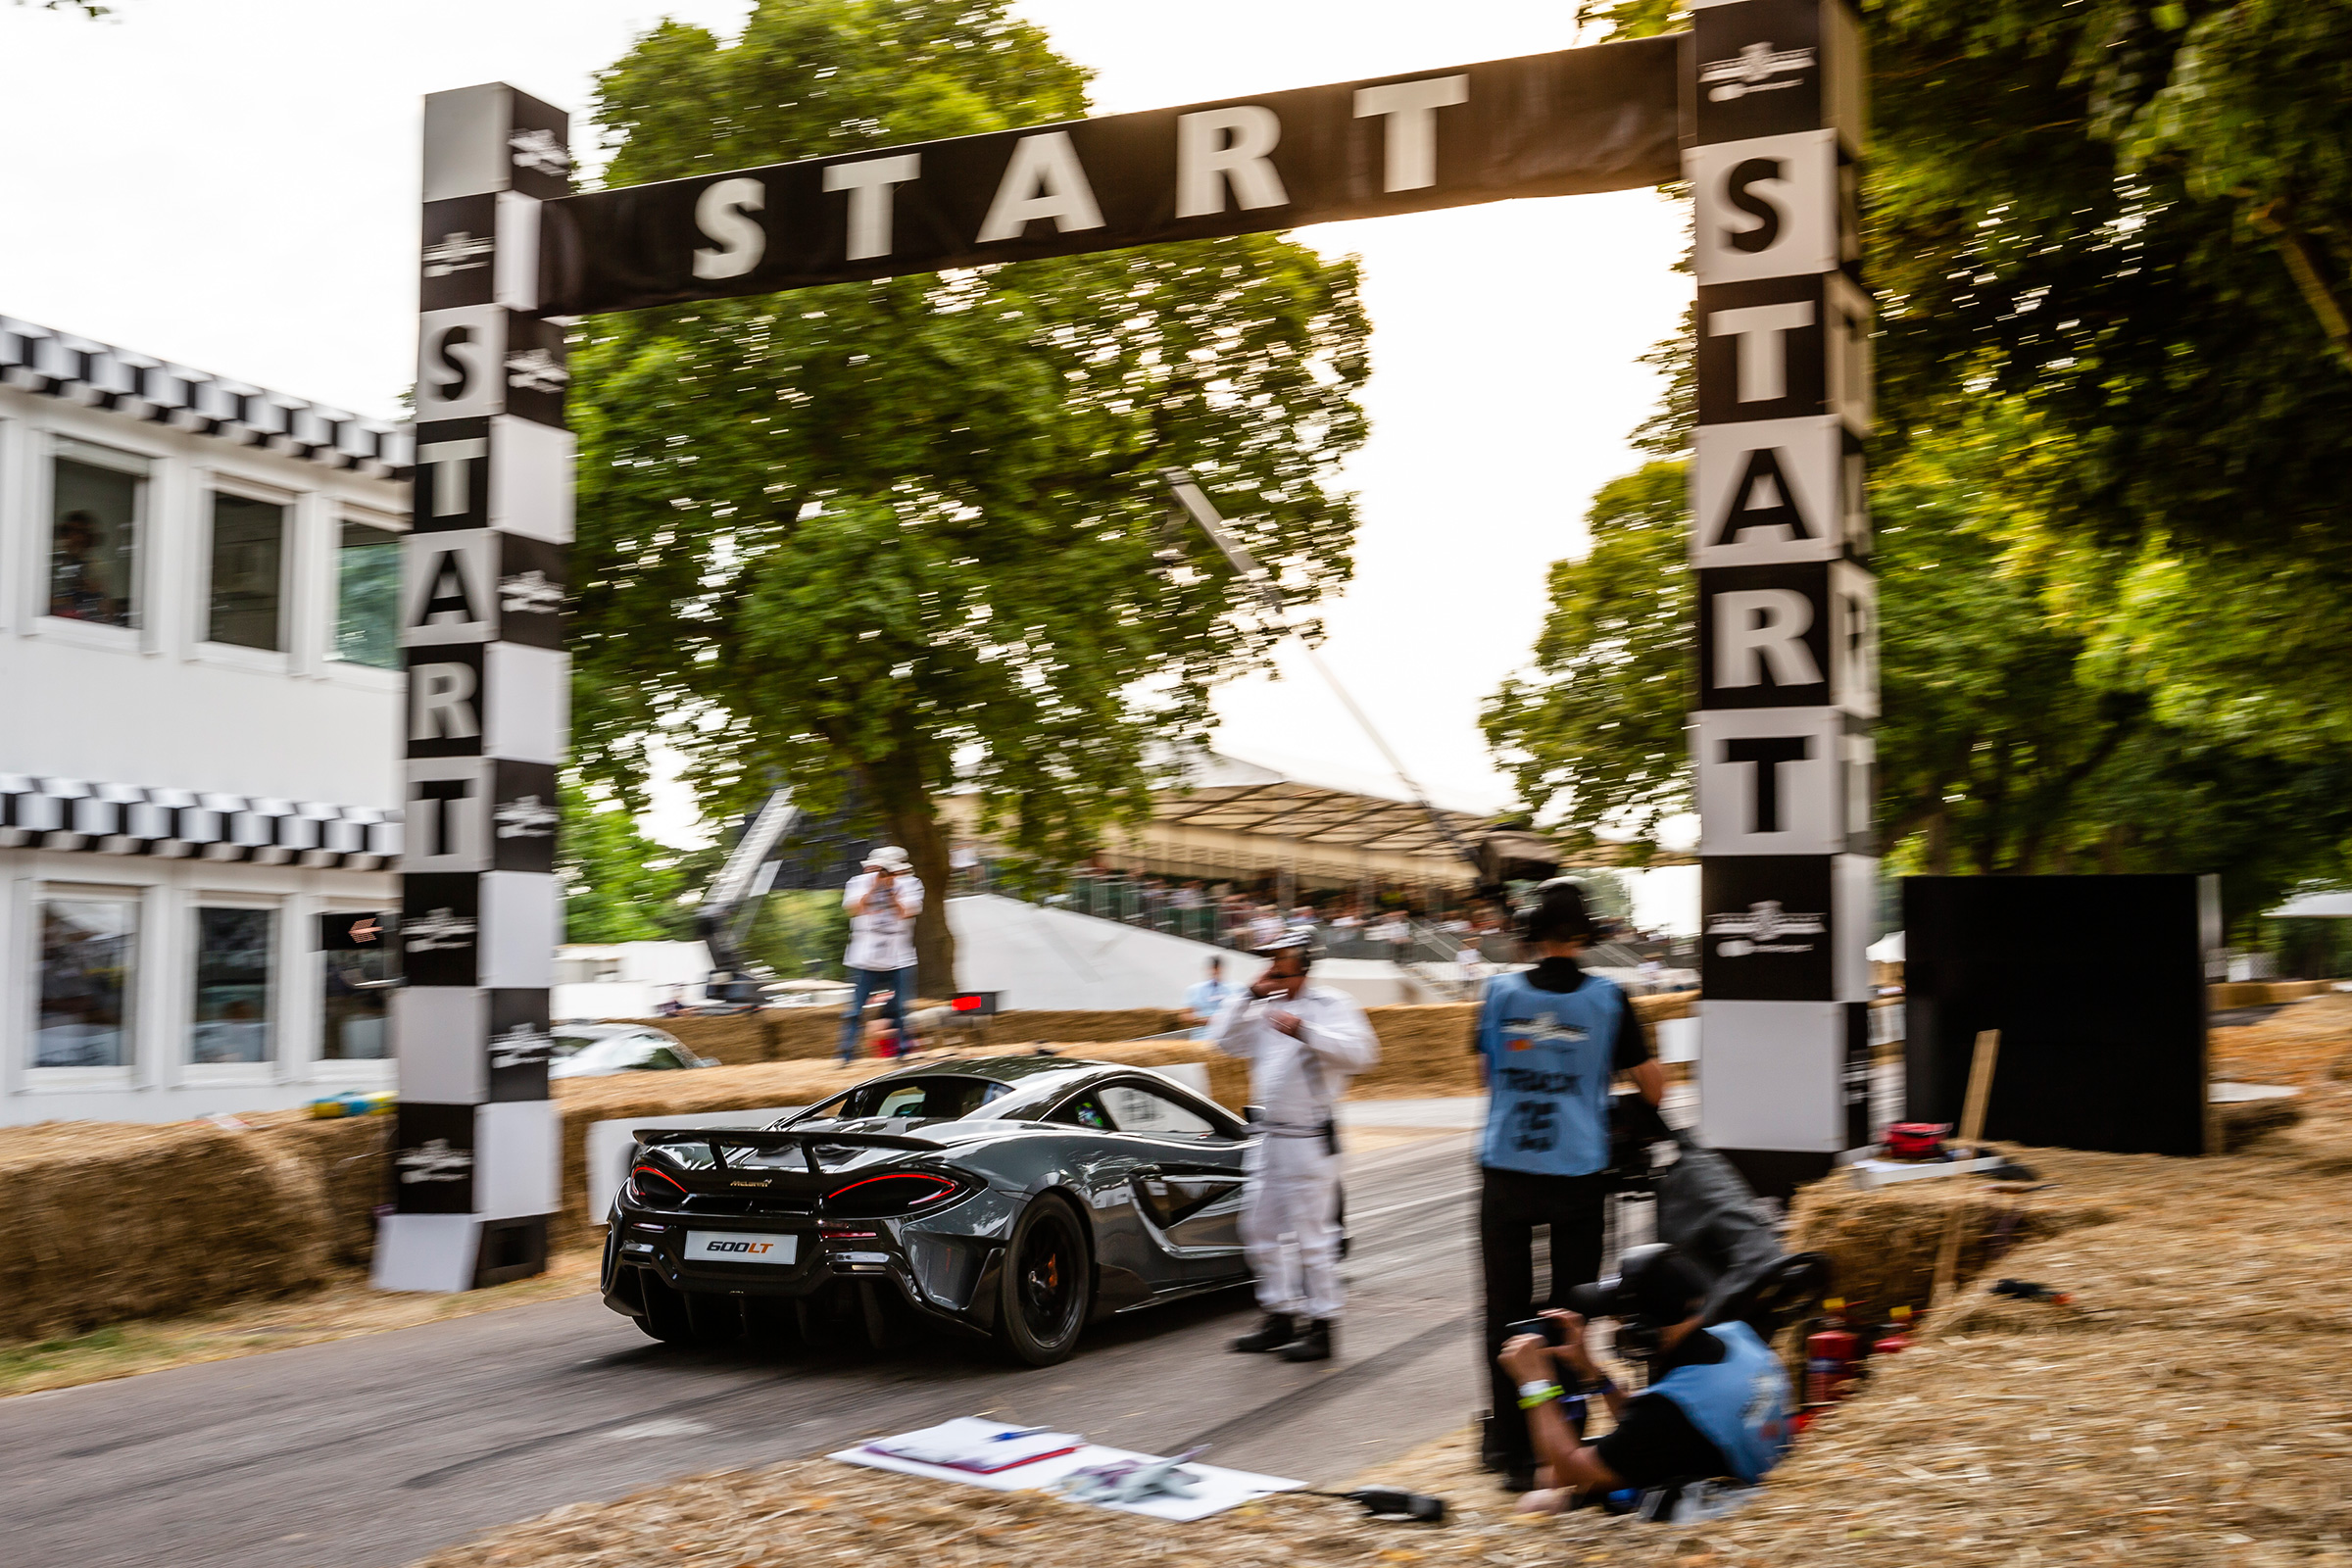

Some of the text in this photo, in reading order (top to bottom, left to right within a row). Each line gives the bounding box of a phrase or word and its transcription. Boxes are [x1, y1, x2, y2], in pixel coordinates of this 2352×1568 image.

[692, 74, 1470, 279] START
[408, 324, 487, 856] START
[1704, 157, 1826, 834] START
[707, 1241, 774, 1253] 600LT
